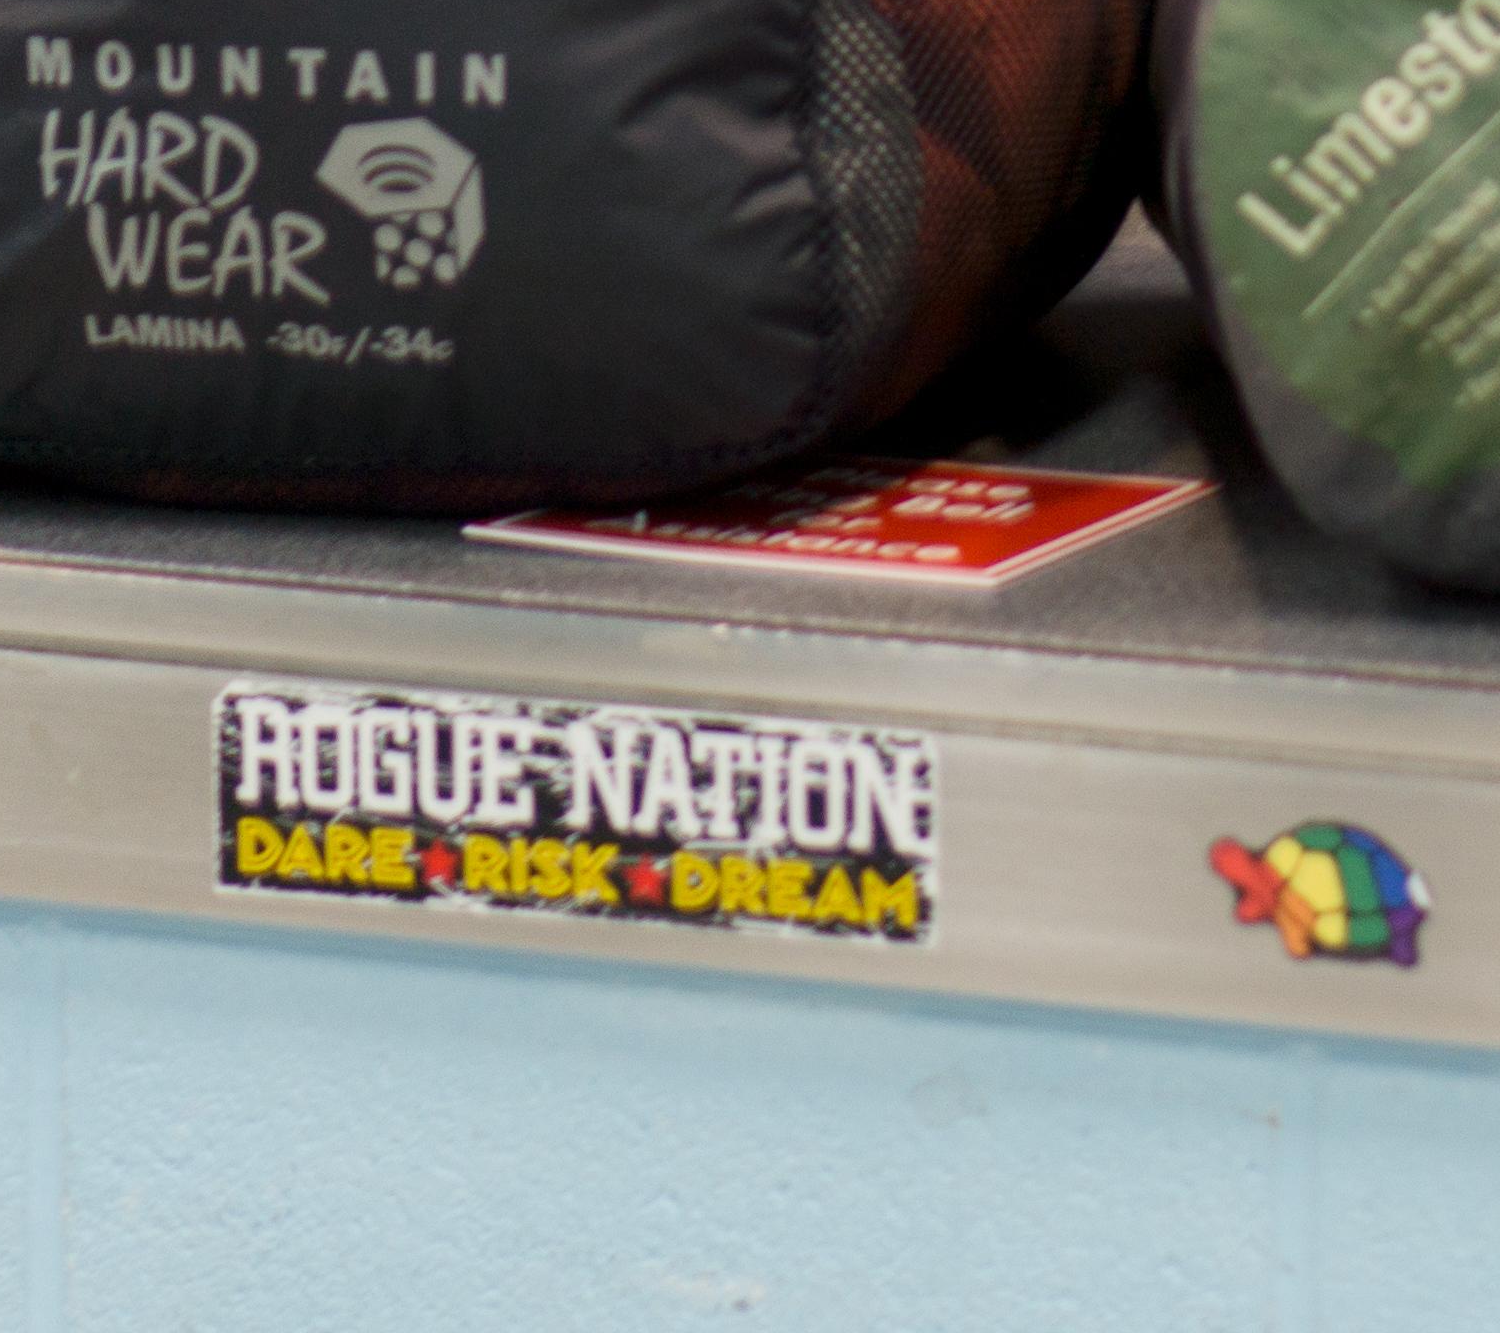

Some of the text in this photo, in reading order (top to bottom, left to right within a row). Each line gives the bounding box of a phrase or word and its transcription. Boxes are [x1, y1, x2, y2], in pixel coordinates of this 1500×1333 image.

[26, 34, 506, 106] MOUNTAIN
[40, 106, 260, 212] HARD
[87, 202, 331, 306] WEAR
[84, 314, 245, 351] LAMINA
[233, 695, 938, 859] ROGUE NATION
[235, 815, 918, 932] DARE RISK DREAM
